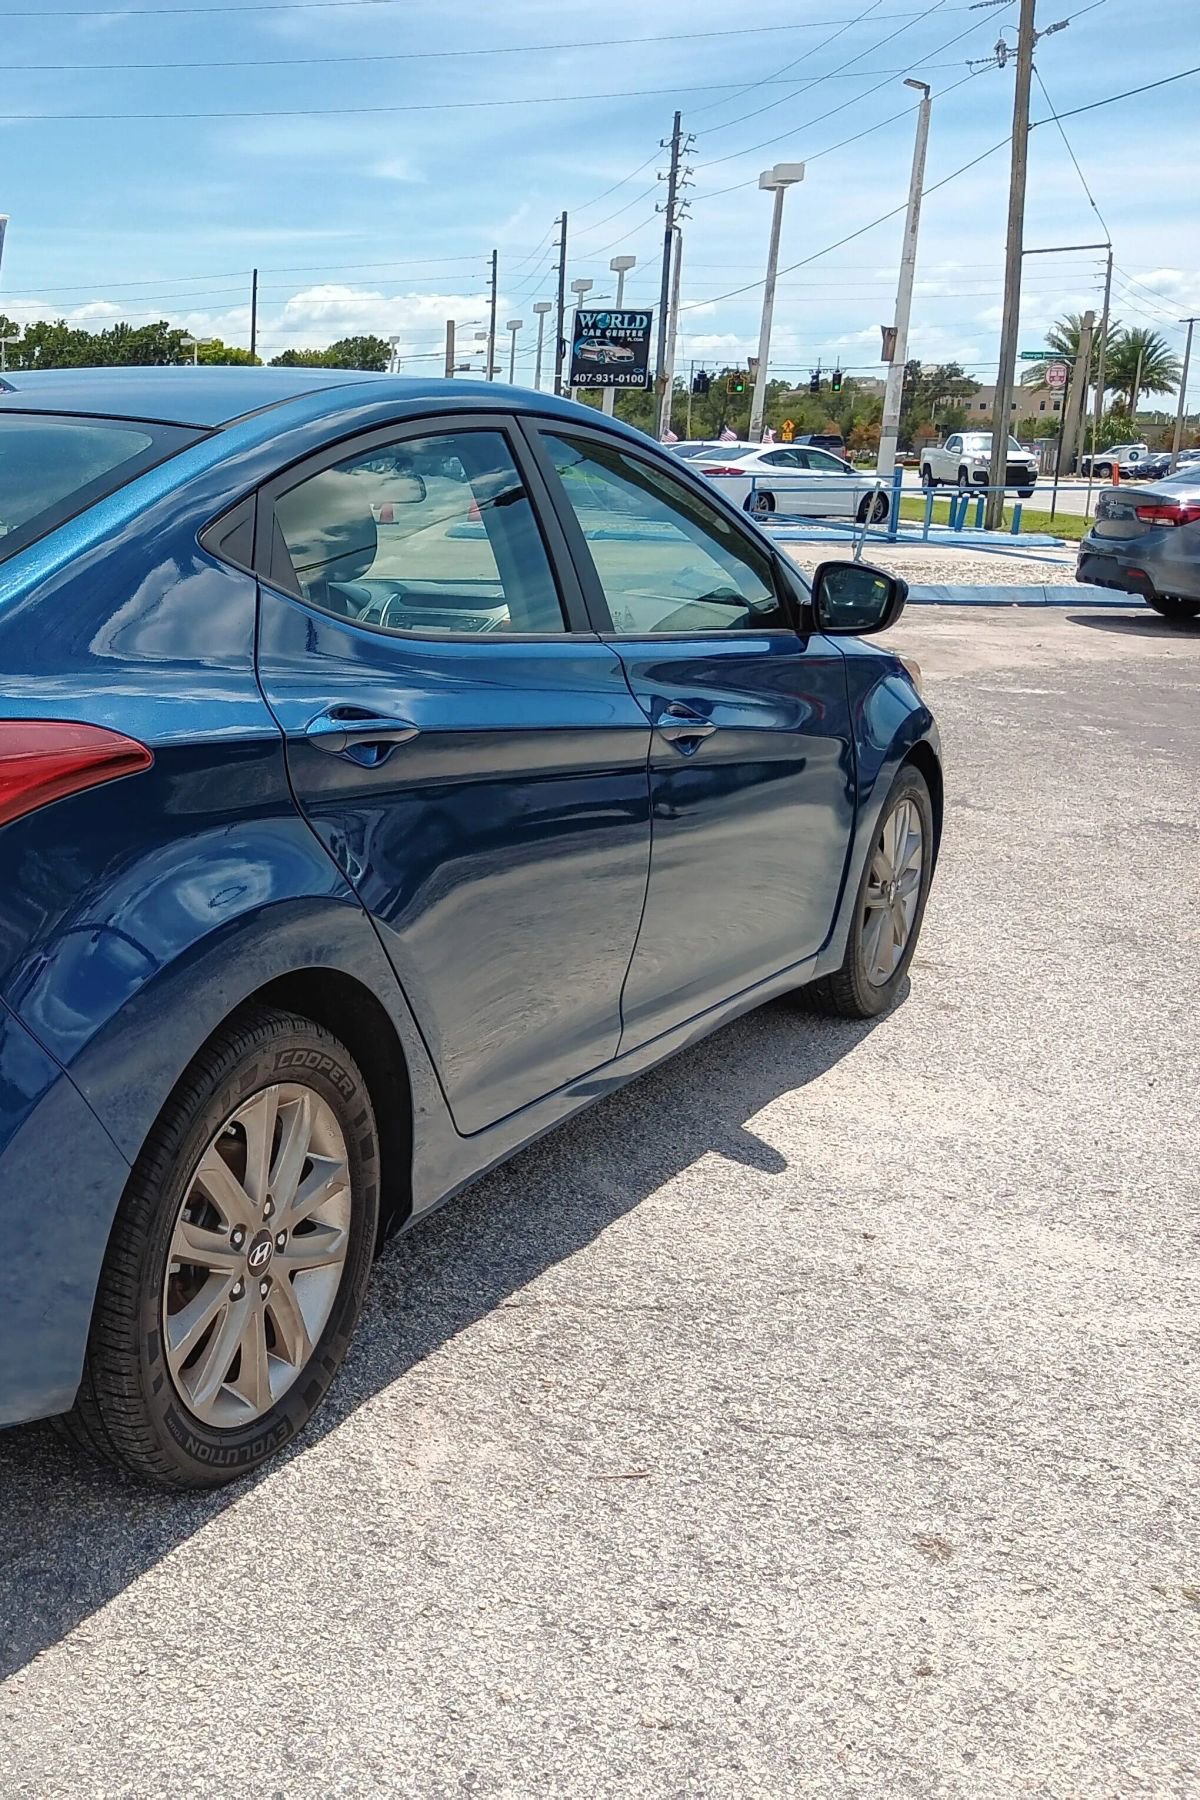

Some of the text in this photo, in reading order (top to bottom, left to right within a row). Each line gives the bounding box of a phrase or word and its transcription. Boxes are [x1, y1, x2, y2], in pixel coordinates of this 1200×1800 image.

[578, 312, 648, 329] WORLD
[582, 329, 644, 337] CAR CENTER
[573, 373, 644, 383] 407-931-0100
[277, 1050, 354, 1096] COOPER
[166, 1416, 289, 1464] EVOLUTION TOUR
